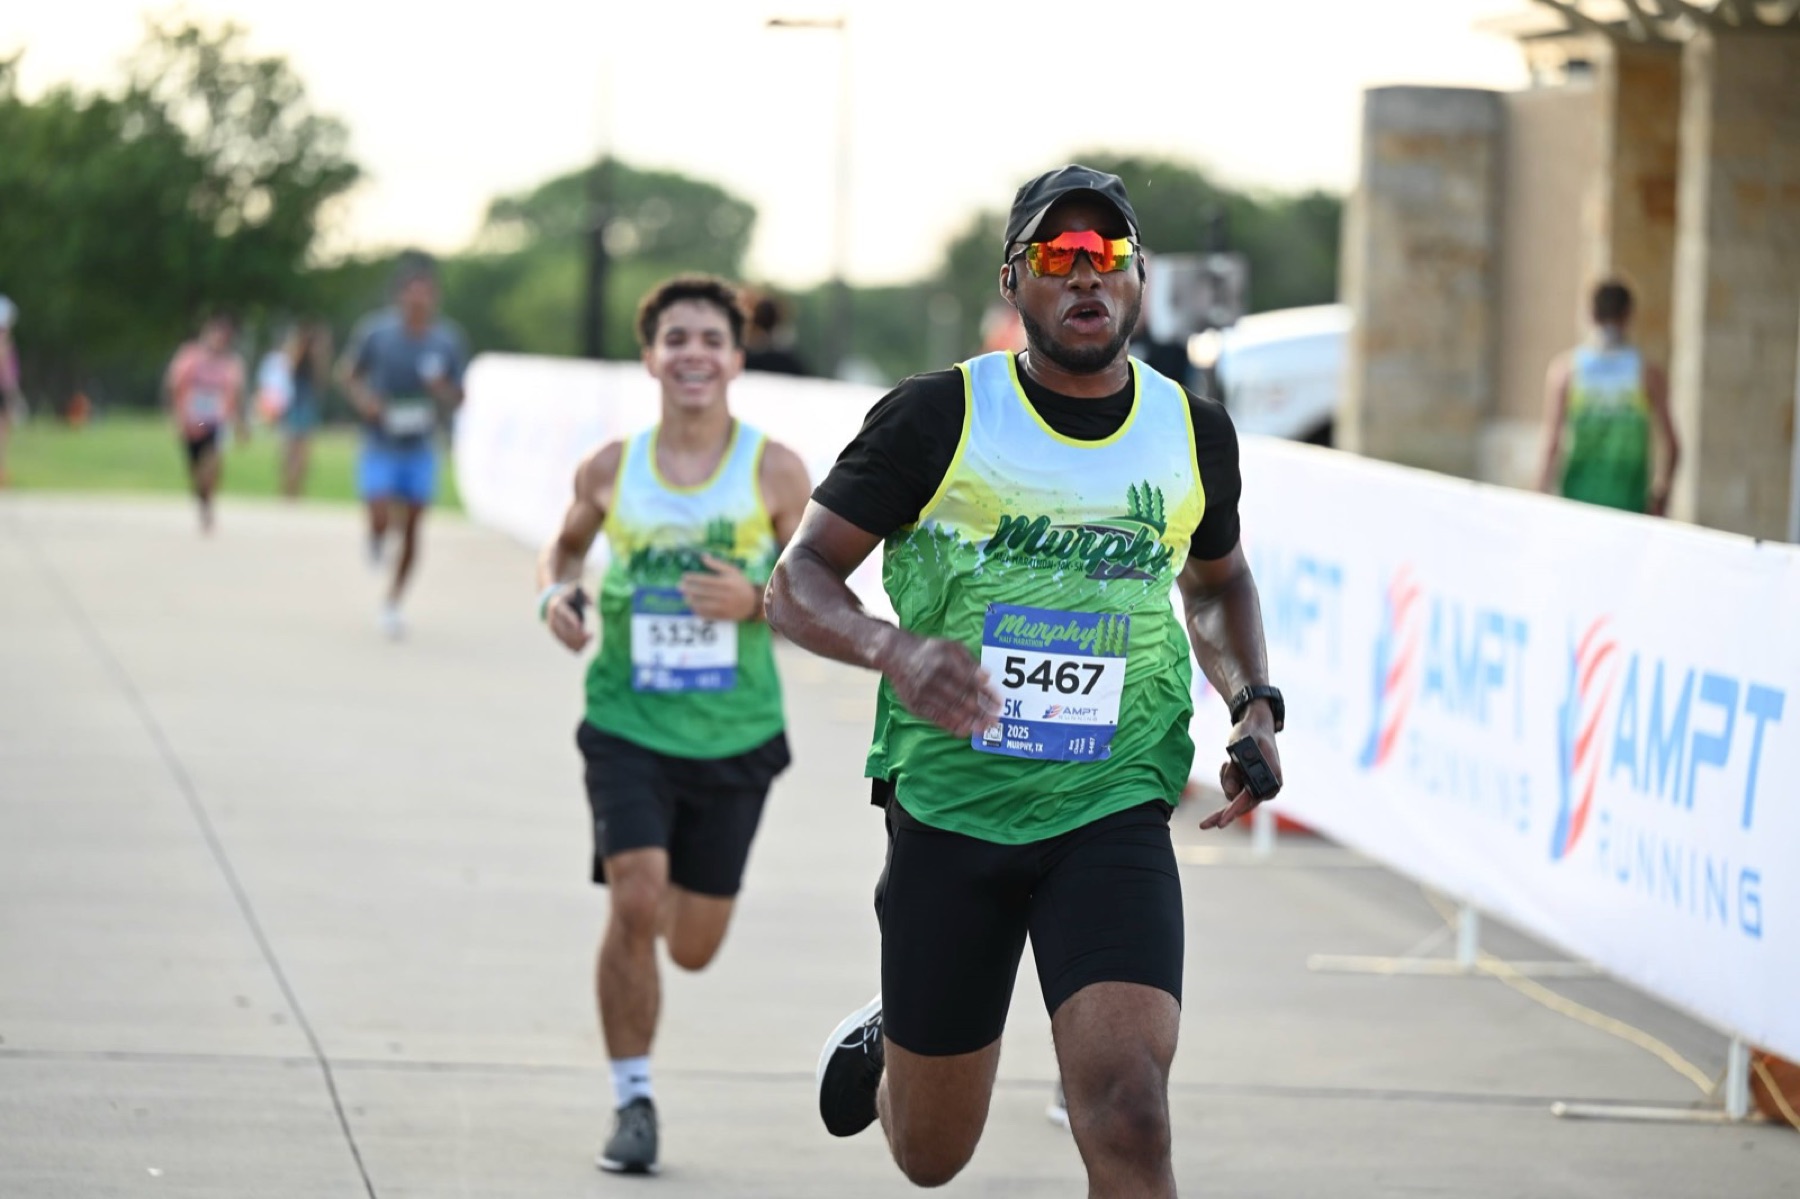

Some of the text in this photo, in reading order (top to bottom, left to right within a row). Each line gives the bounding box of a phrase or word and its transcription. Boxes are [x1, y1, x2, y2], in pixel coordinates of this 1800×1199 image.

[983, 515, 1175, 575] Murphy
[993, 614, 1097, 650] Murphy
[999, 636, 1044, 648] HALF MARATHON
[1002, 656, 1105, 695] 5467
[1004, 698, 1023, 718] 5K
[1062, 706, 1099, 716] AMPT
[1007, 725, 1029, 738] 2025
[1609, 649, 1786, 831] AMPT
[1006, 740, 1034, 753] MURPHY,
[1035, 743, 1044, 752] TX
[1598, 809, 1763, 941] RUNNING
